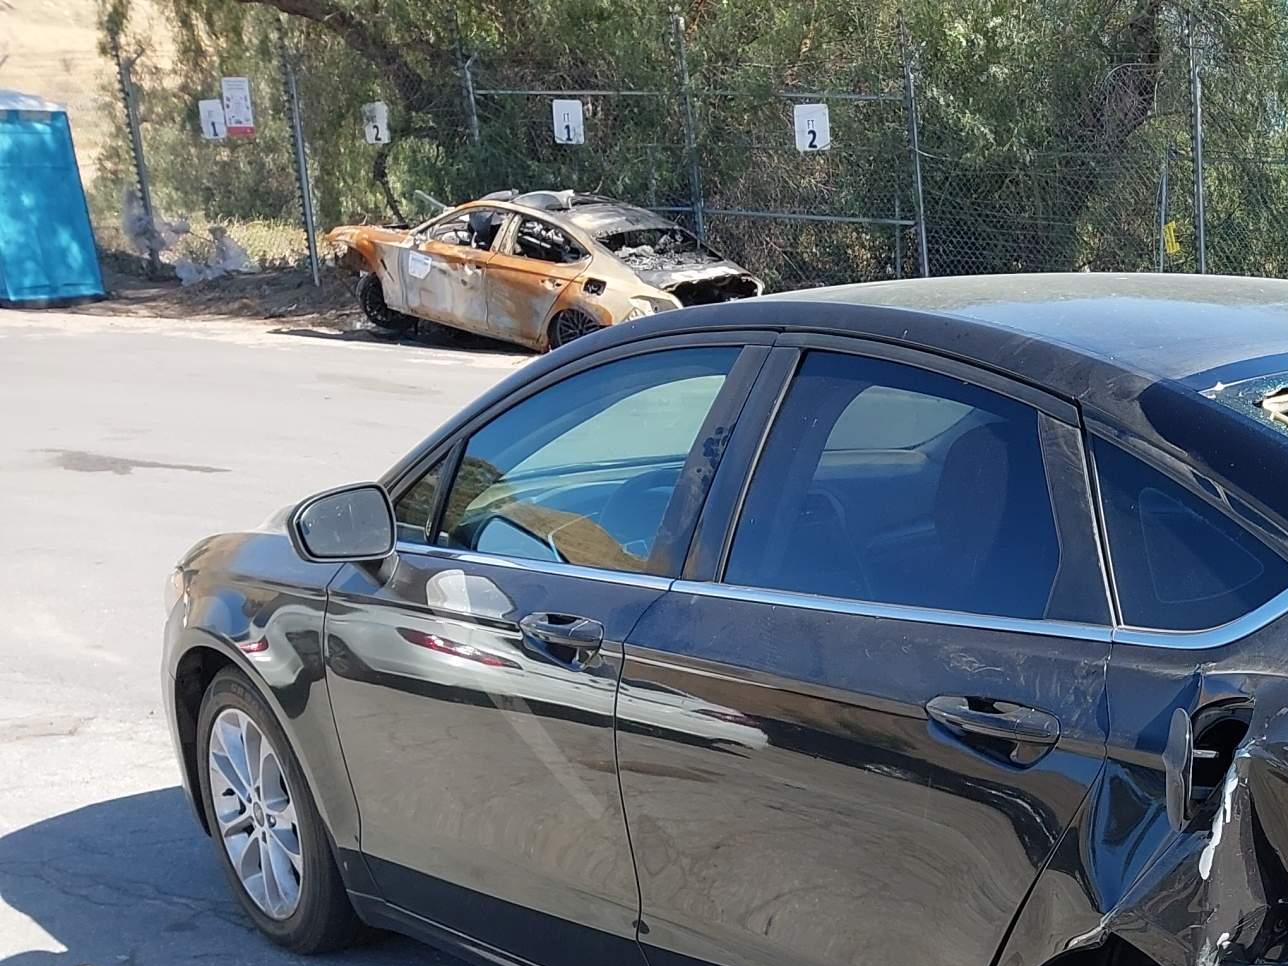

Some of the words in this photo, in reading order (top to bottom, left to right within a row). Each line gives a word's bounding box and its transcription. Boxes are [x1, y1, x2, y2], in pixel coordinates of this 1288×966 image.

[373, 125, 382, 141] 2
[564, 124, 573, 141] 1
[808, 130, 818, 148] 2
